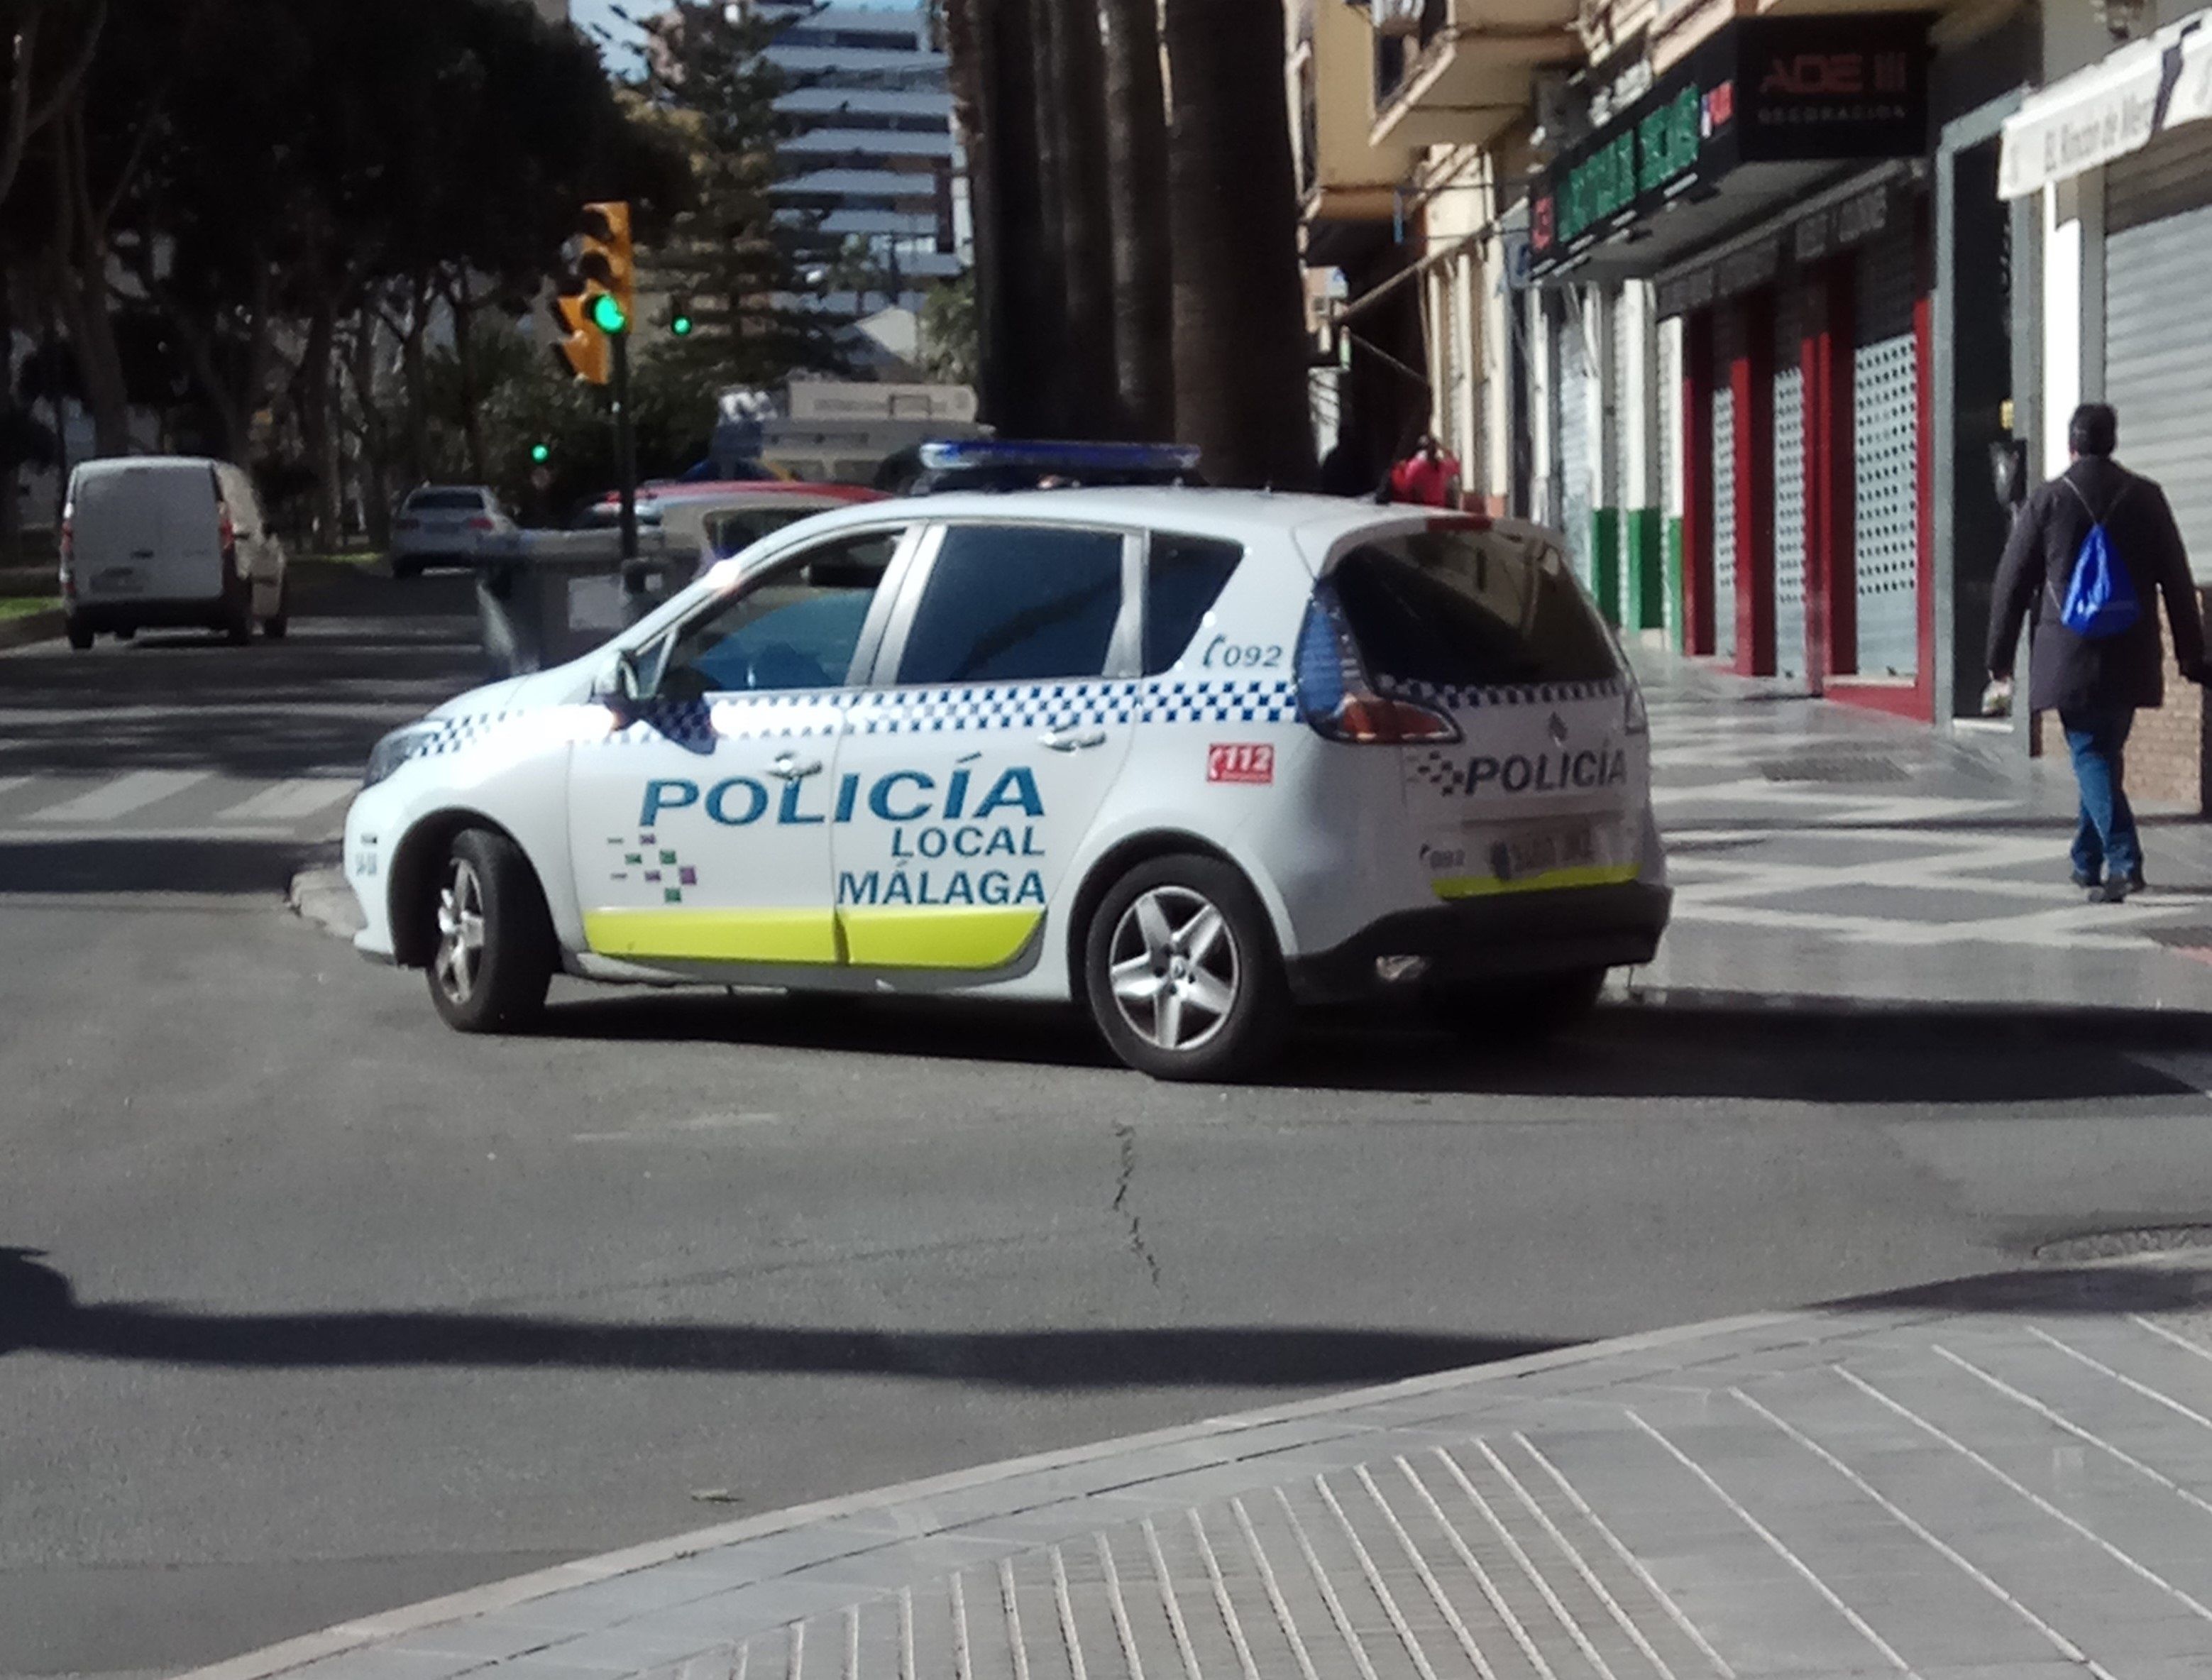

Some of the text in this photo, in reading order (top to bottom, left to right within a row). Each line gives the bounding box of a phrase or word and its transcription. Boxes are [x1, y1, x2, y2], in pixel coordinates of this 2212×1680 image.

[1759, 53, 1864, 94] ADE
[1223, 644, 1283, 667] 092
[1226, 746, 1272, 772] 112
[1464, 736, 1628, 796] POLICÍA
[639, 752, 1046, 827] POLICÍA
[890, 825, 1047, 860] LOCAL
[837, 859, 1047, 906] MÁLAGA
